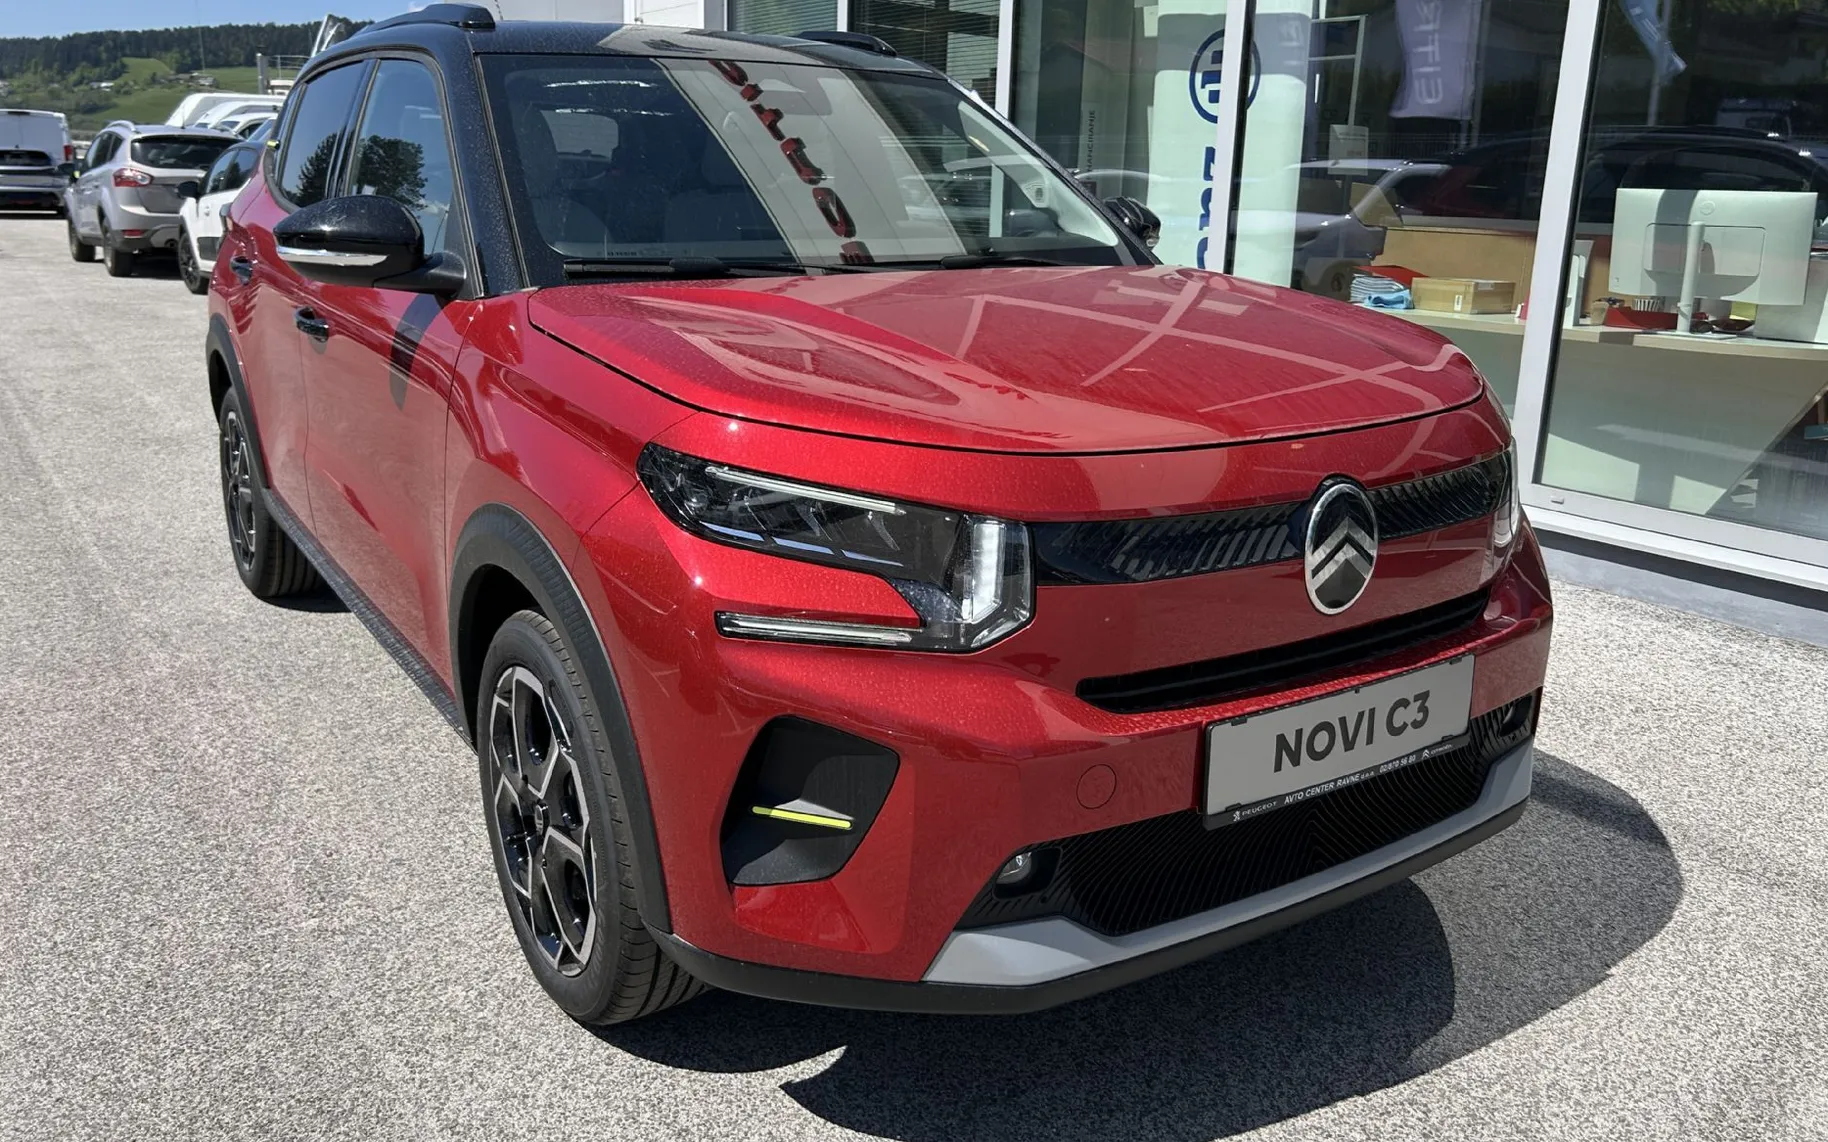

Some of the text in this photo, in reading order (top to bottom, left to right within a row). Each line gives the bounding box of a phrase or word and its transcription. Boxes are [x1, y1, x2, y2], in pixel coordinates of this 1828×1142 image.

[1274, 690, 1431, 773] NOVI C3
[1284, 791, 1304, 805] AVTO
[1306, 782, 1334, 797] CENTER
[1336, 773, 1360, 787] RAVNE
[1242, 801, 1277, 816] PEUGEOT
